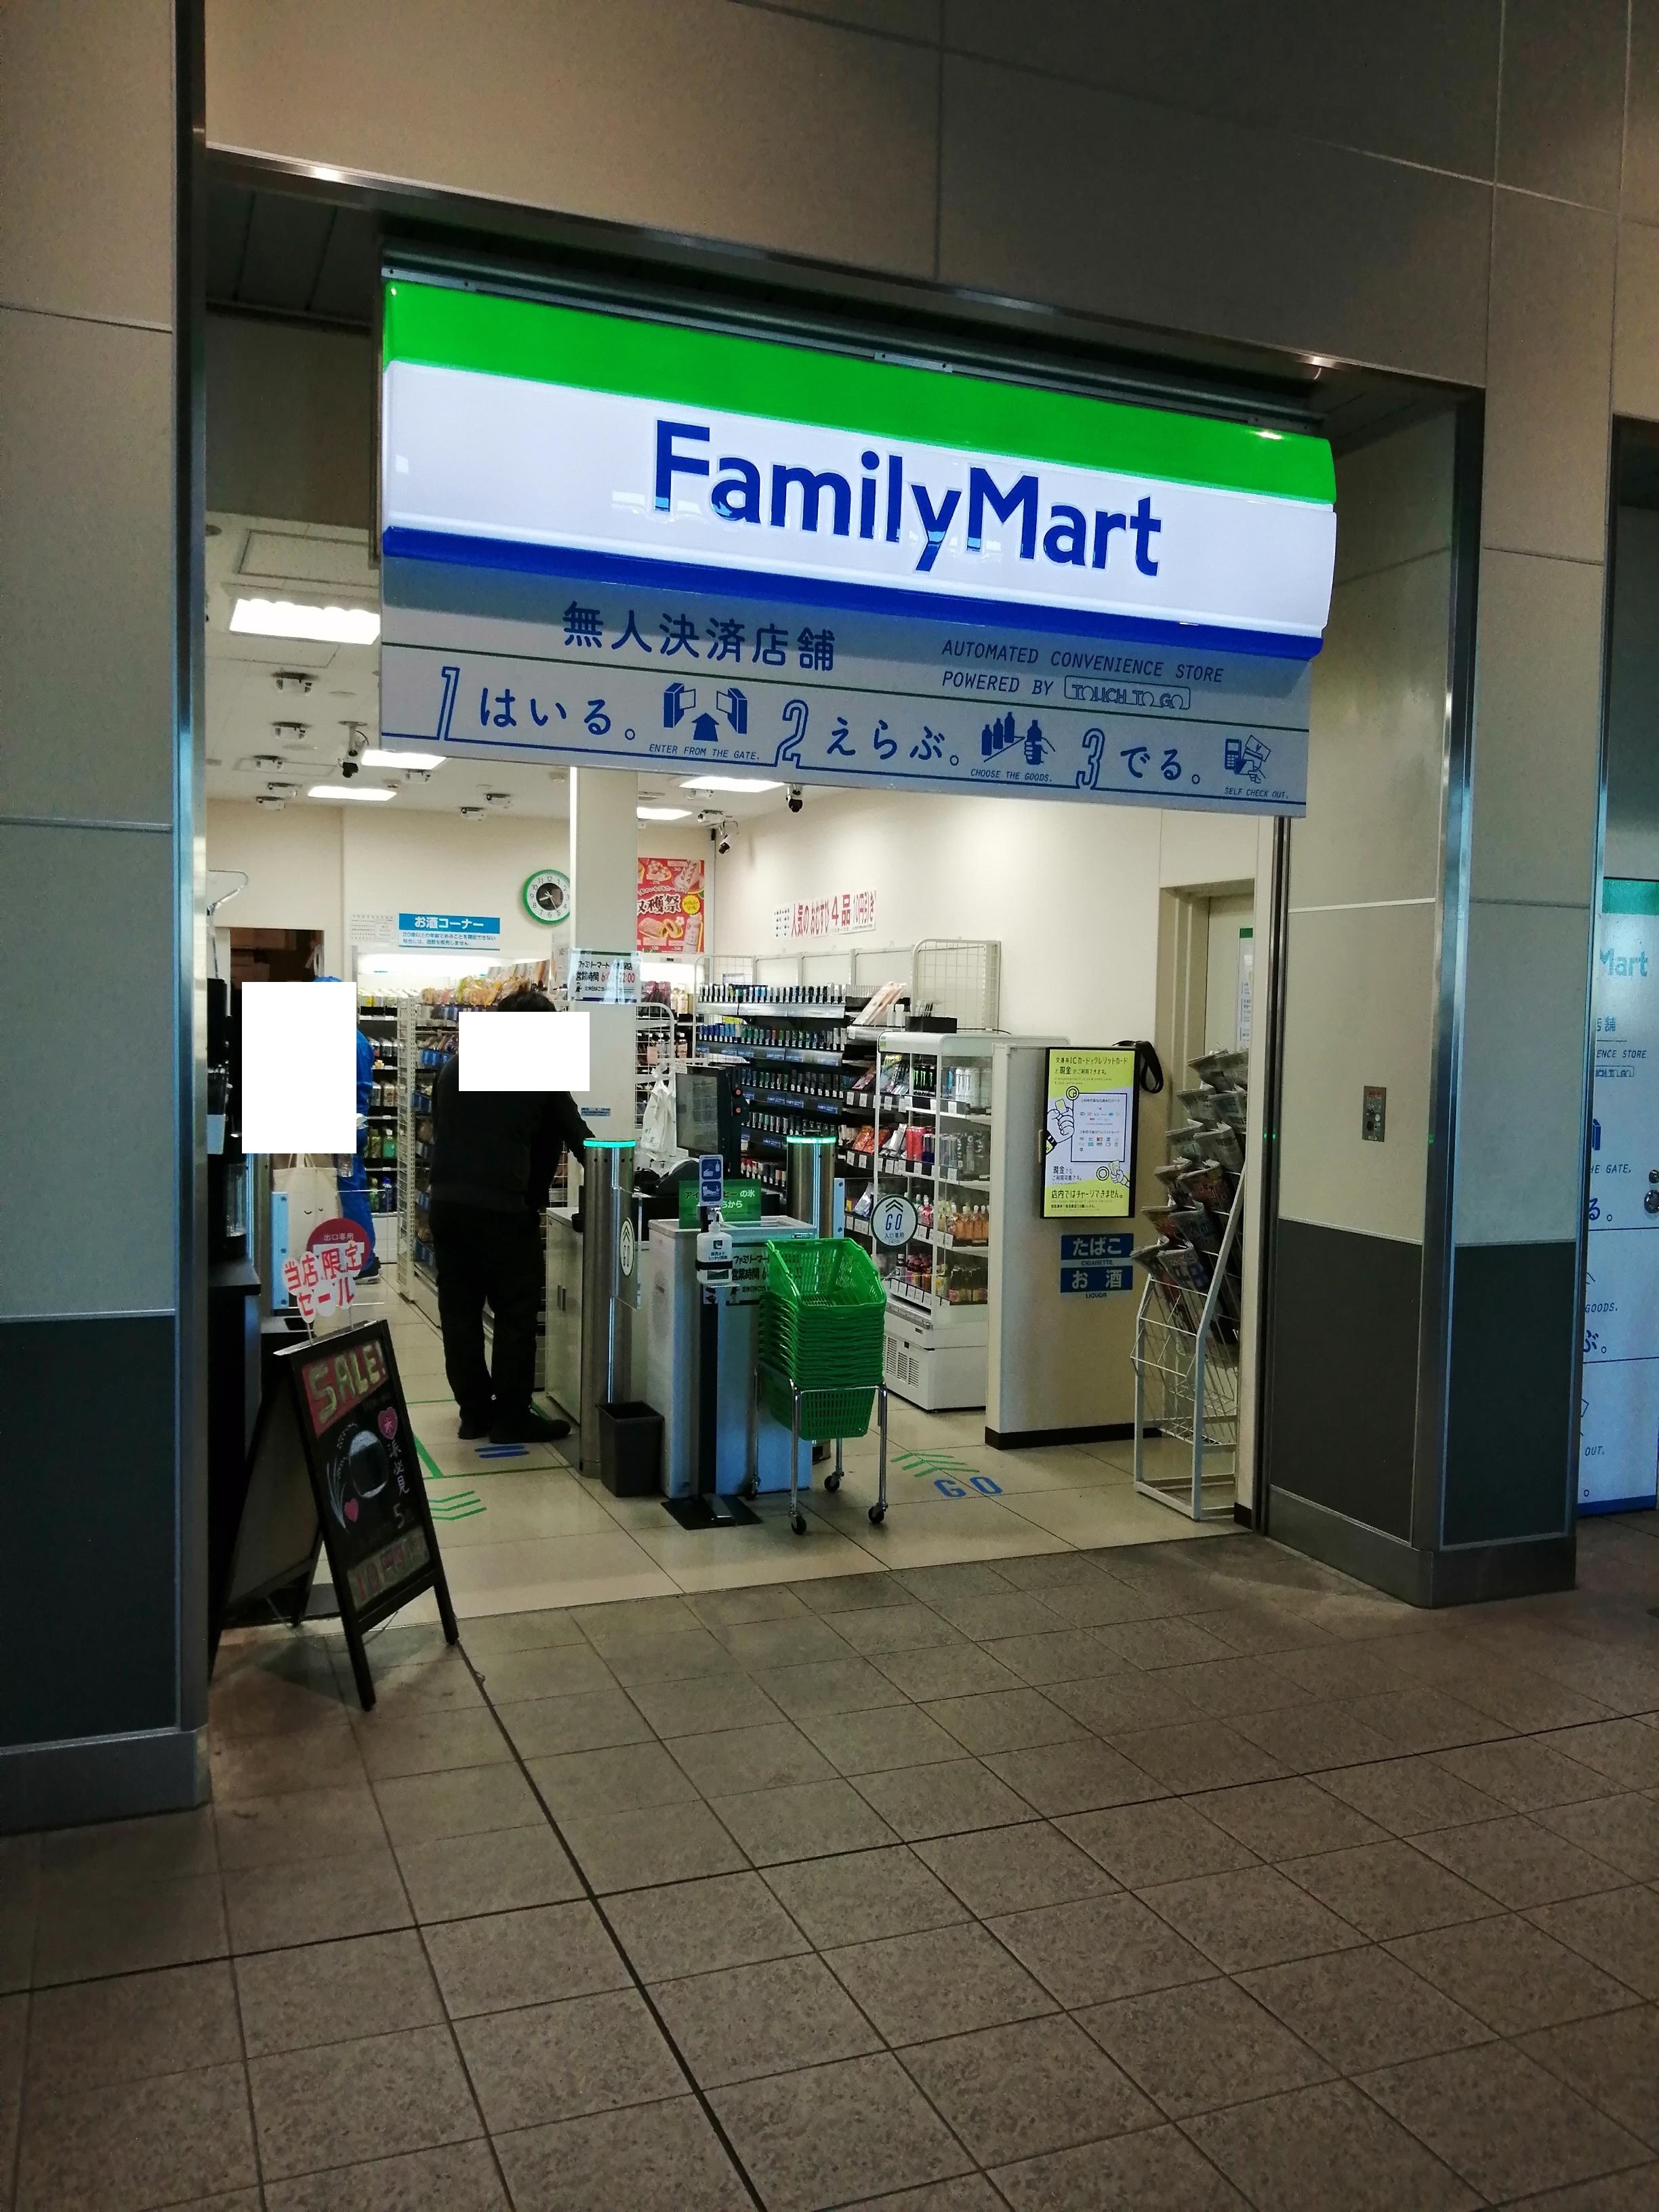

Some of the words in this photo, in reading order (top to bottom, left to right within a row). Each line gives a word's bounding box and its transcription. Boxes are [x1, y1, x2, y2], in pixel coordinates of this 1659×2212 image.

[654, 419, 1162, 577] FamilyMart
[562, 600, 834, 671] 無人決済店舗
[942, 640, 1038, 663] AUTOMATED
[1051, 651, 1164, 676] CONVENIENCE
[1176, 664, 1224, 683] STORE
[942, 671, 1020, 693] POWERED
[1032, 680, 1054, 696] BY
[480, 687, 636, 741] はいる。
[827, 716, 959, 766] えらぶ。
[649, 743, 678, 754] ENTER
[684, 747, 707, 756] FROM
[712, 749, 729, 758] THE
[733, 750, 760, 760] GATE.
[1120, 746, 1200, 786] でる。
[970, 769, 1001, 779] CHOOSE
[1006, 771, 1021, 780] THE
[1024, 773, 1052, 782] GOODS.
[1224, 787, 1243, 796] SELF
[1246, 789, 1269, 797] CHECK
[1271, 791, 1289, 799] OUT.
[414, 916, 484, 929] お酒コーナー
[1622, 1050, 1647, 1059] STORE
[1605, 1164, 1631, 1174] GATE.
[1051, 1190, 1123, 1199] 店内ではチャージできません。
[885, 1214, 903, 1231] GO
[324, 1232, 354, 1242] 出口専用
[1072, 1236, 1122, 1256] たばこ
[284, 1244, 362, 1291] 当店限定
[298, 1276, 355, 1317] セール
[1585, 1303, 1618, 1313] GOODS.
[1584, 1446, 1605, 1456] OUT.
[933, 1476, 1003, 1498] GO
